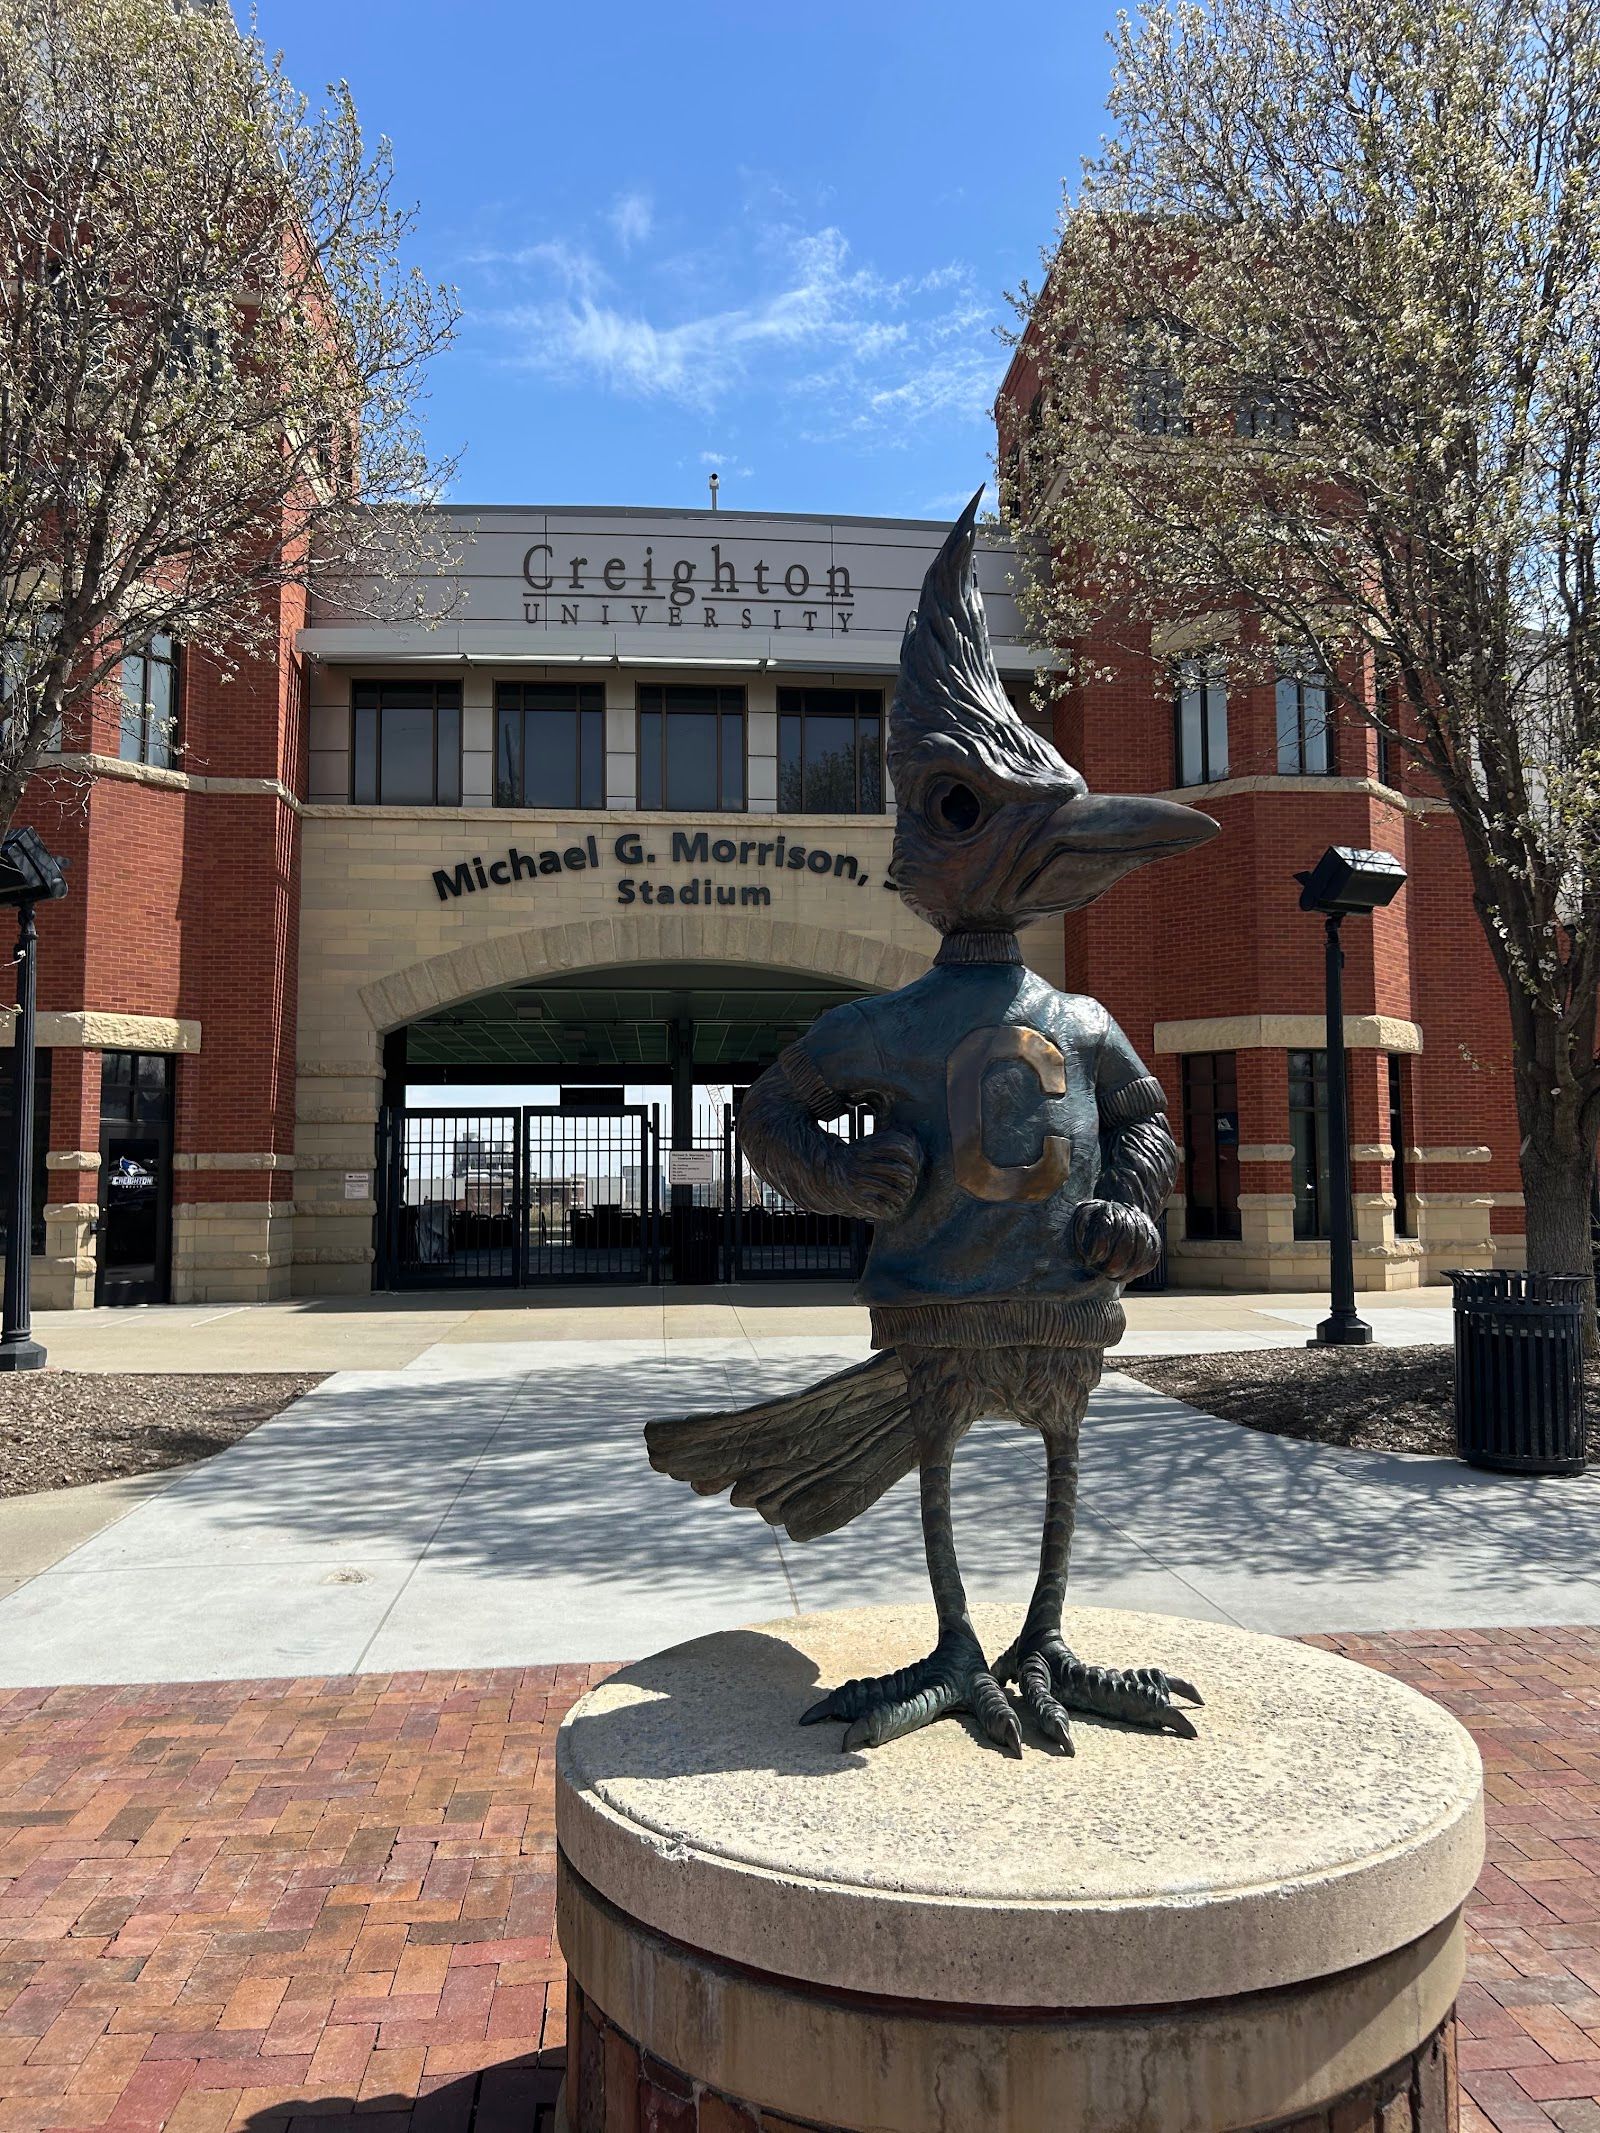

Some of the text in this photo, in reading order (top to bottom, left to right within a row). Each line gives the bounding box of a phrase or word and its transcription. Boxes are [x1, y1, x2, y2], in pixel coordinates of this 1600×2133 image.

[523, 544, 854, 606] Creighton
[523, 603, 853, 632] UNIVERSITY
[432, 835, 599, 901] Michael
[614, 833, 656, 865] G.
[672, 832, 869, 887] Morrison,
[617, 879, 771, 906] Stadium
[111, 1176, 153, 1186] CREIGHTON
